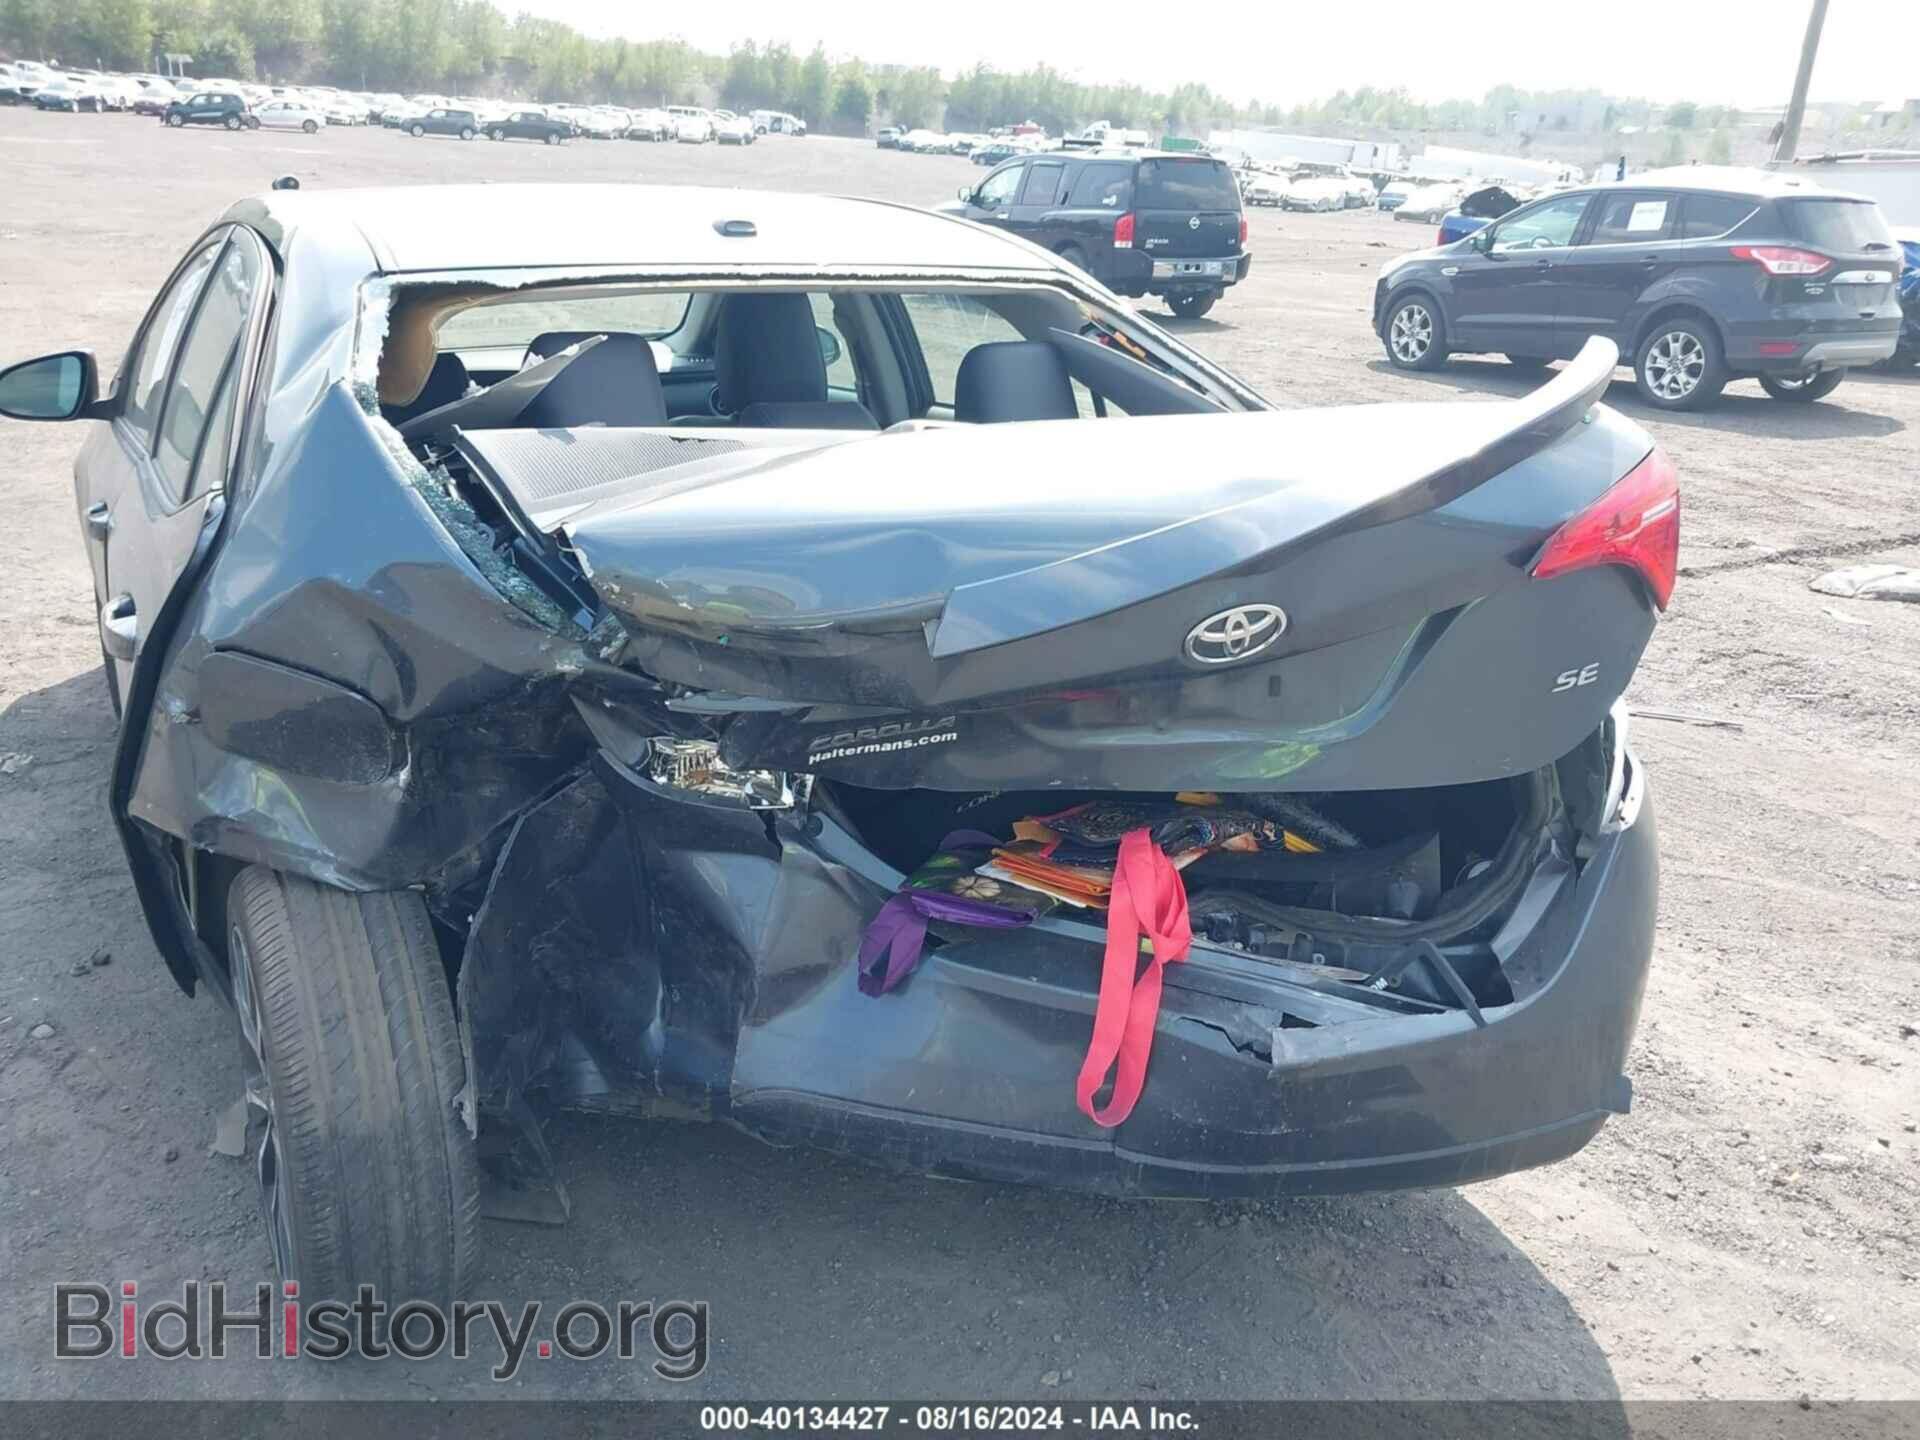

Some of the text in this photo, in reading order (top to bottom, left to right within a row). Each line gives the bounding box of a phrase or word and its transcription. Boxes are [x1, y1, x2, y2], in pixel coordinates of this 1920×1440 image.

[1551, 662, 1600, 693] SE
[808, 732, 958, 766] Haltermans.com
[809, 715, 957, 751] COROLLA
